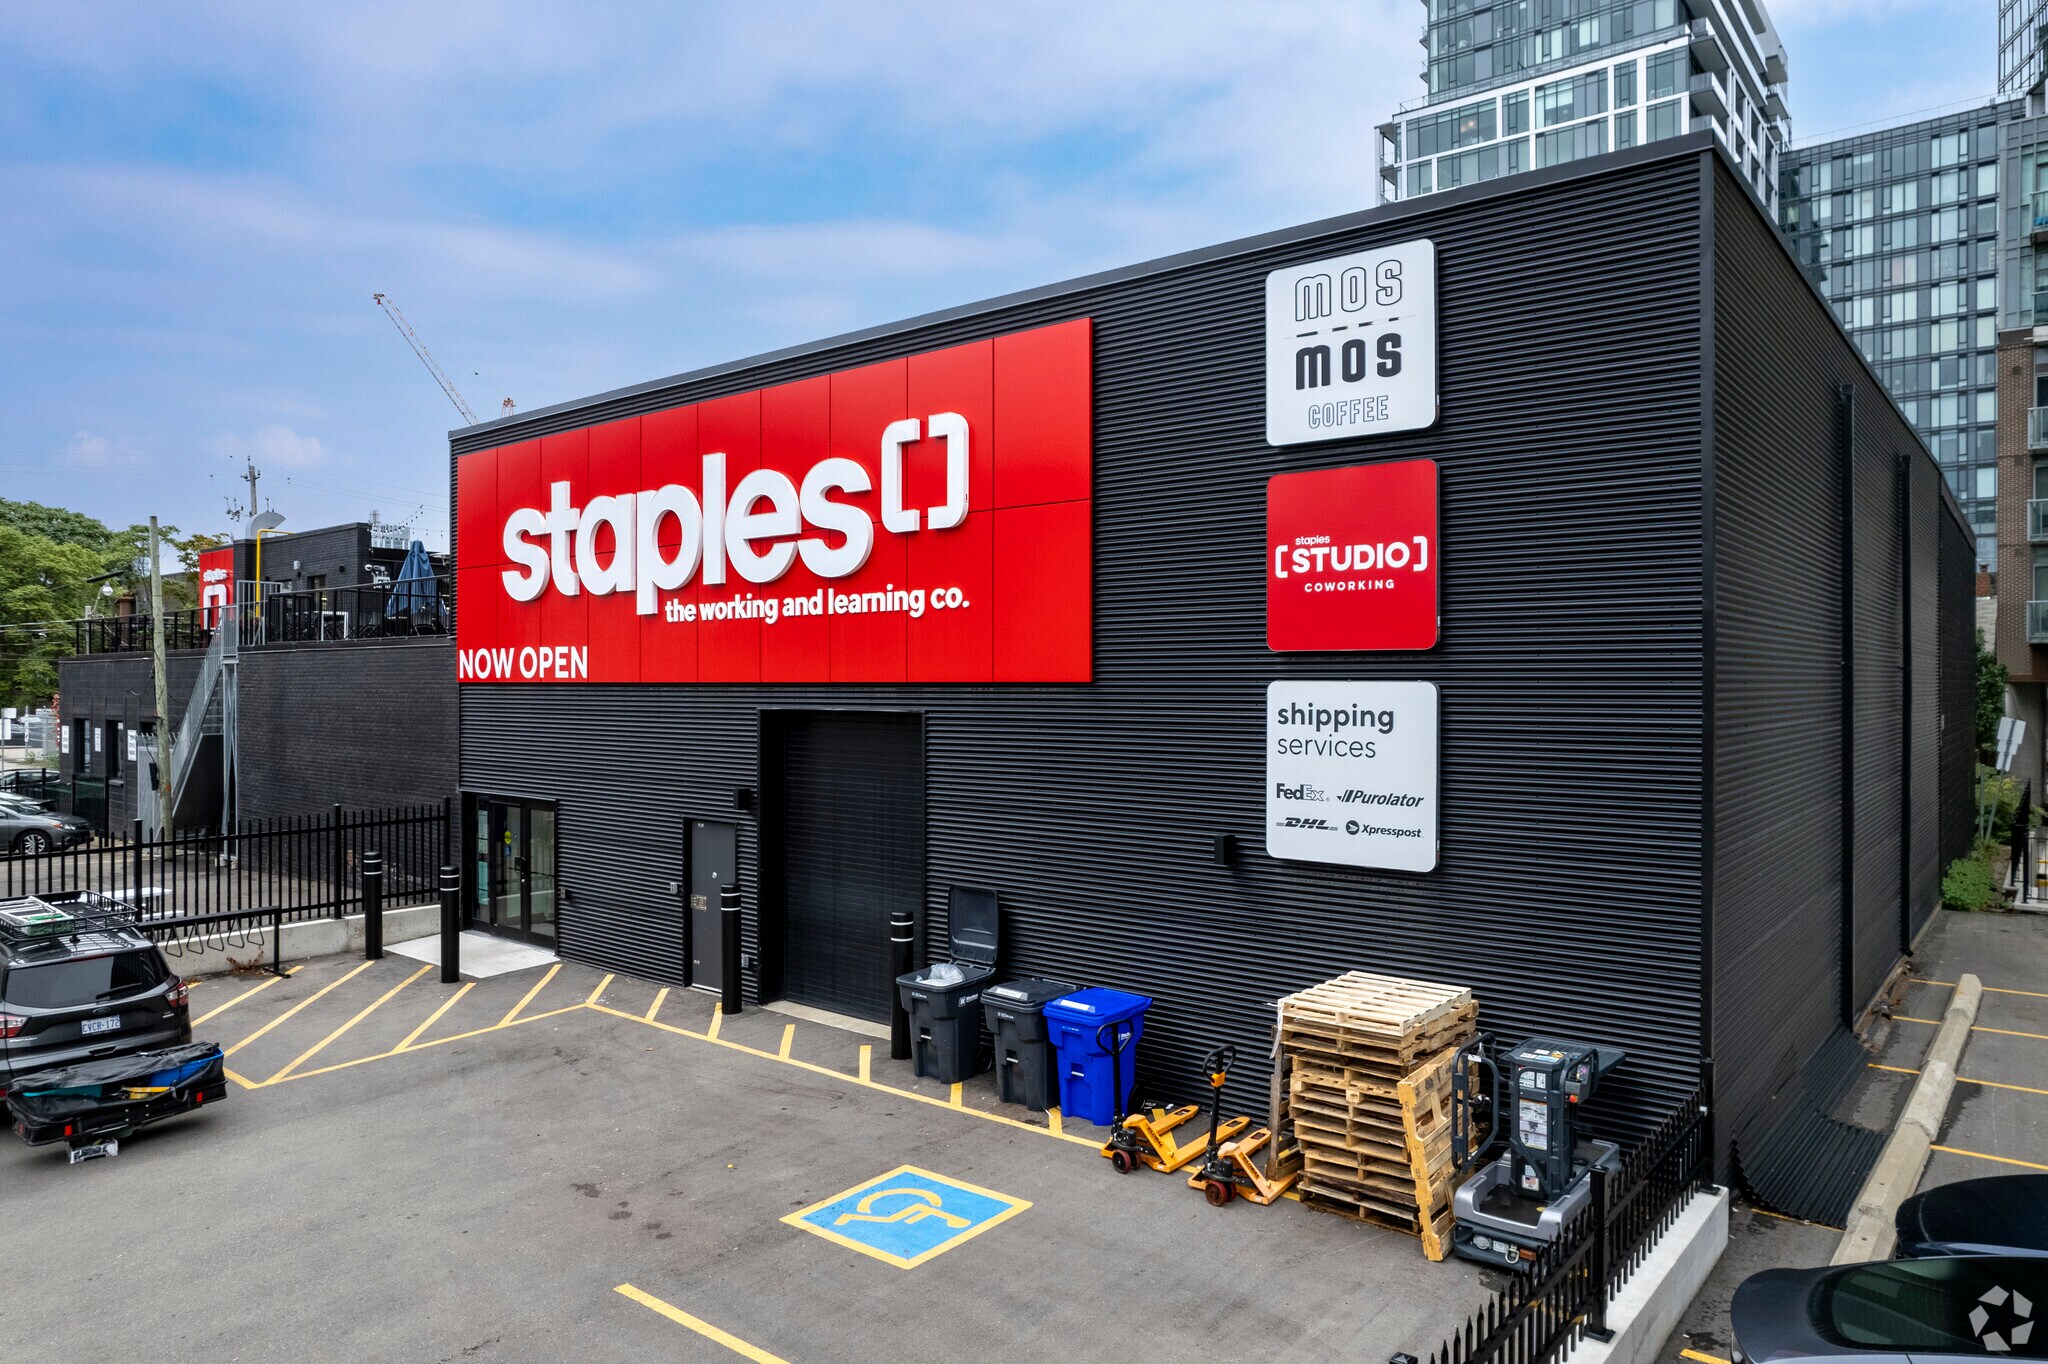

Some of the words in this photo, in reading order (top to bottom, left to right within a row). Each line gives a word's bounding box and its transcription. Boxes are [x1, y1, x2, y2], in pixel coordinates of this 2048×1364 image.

[1308, 395, 1389, 429] COFFEE
[1295, 535, 1331, 546] staples
[1304, 579, 1395, 593] COWORKING
[665, 598, 697, 623] the
[699, 593, 779, 624] working
[782, 589, 824, 616] and
[828, 584, 925, 618] learning
[930, 587, 970, 609] co.
[459, 647, 515, 679] NOW
[519, 646, 588, 679] OPEN
[1277, 702, 1394, 734] shipping
[1277, 734, 1376, 758] services
[1276, 783, 1324, 801] FedEx
[1352, 790, 1424, 807] Purolator
[1284, 817, 1330, 831] DHL
[1361, 824, 1422, 838] Xpresspost
